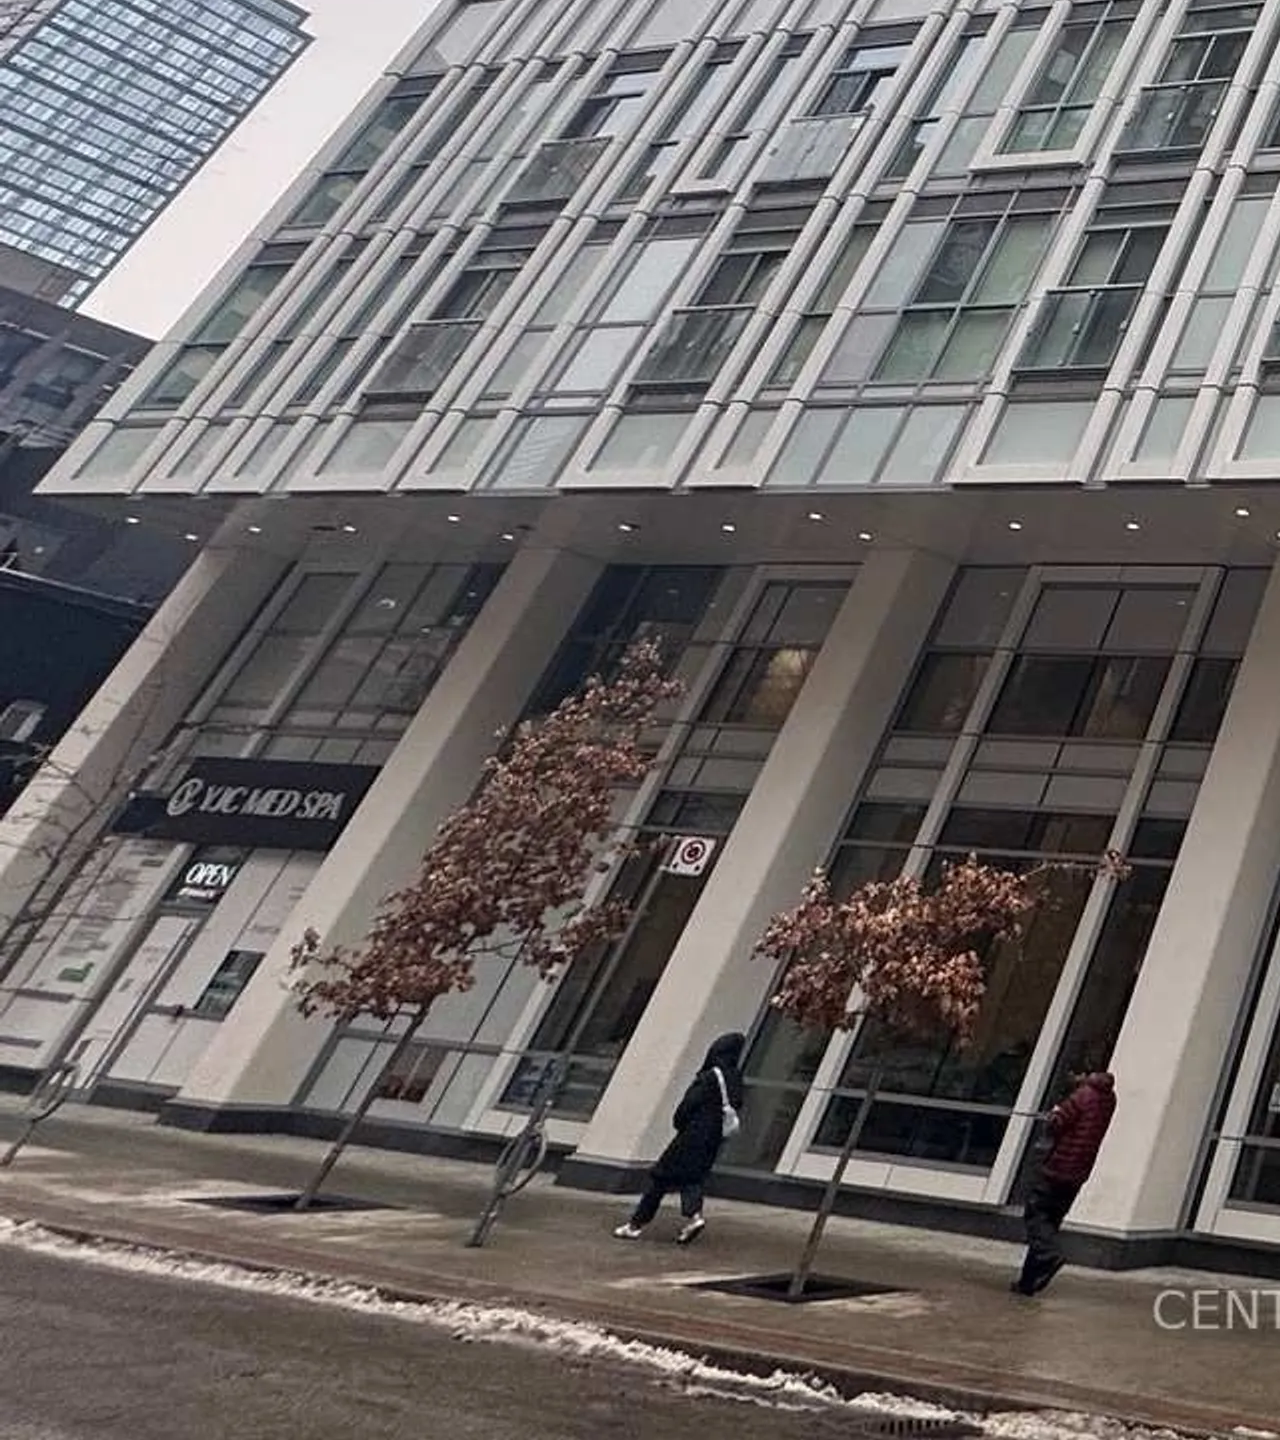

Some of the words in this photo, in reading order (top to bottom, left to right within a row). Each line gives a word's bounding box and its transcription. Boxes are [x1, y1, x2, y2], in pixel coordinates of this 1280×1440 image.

[240, 789, 302, 816] MED
[295, 791, 346, 820] SPA
[186, 862, 237, 887] OPEN
